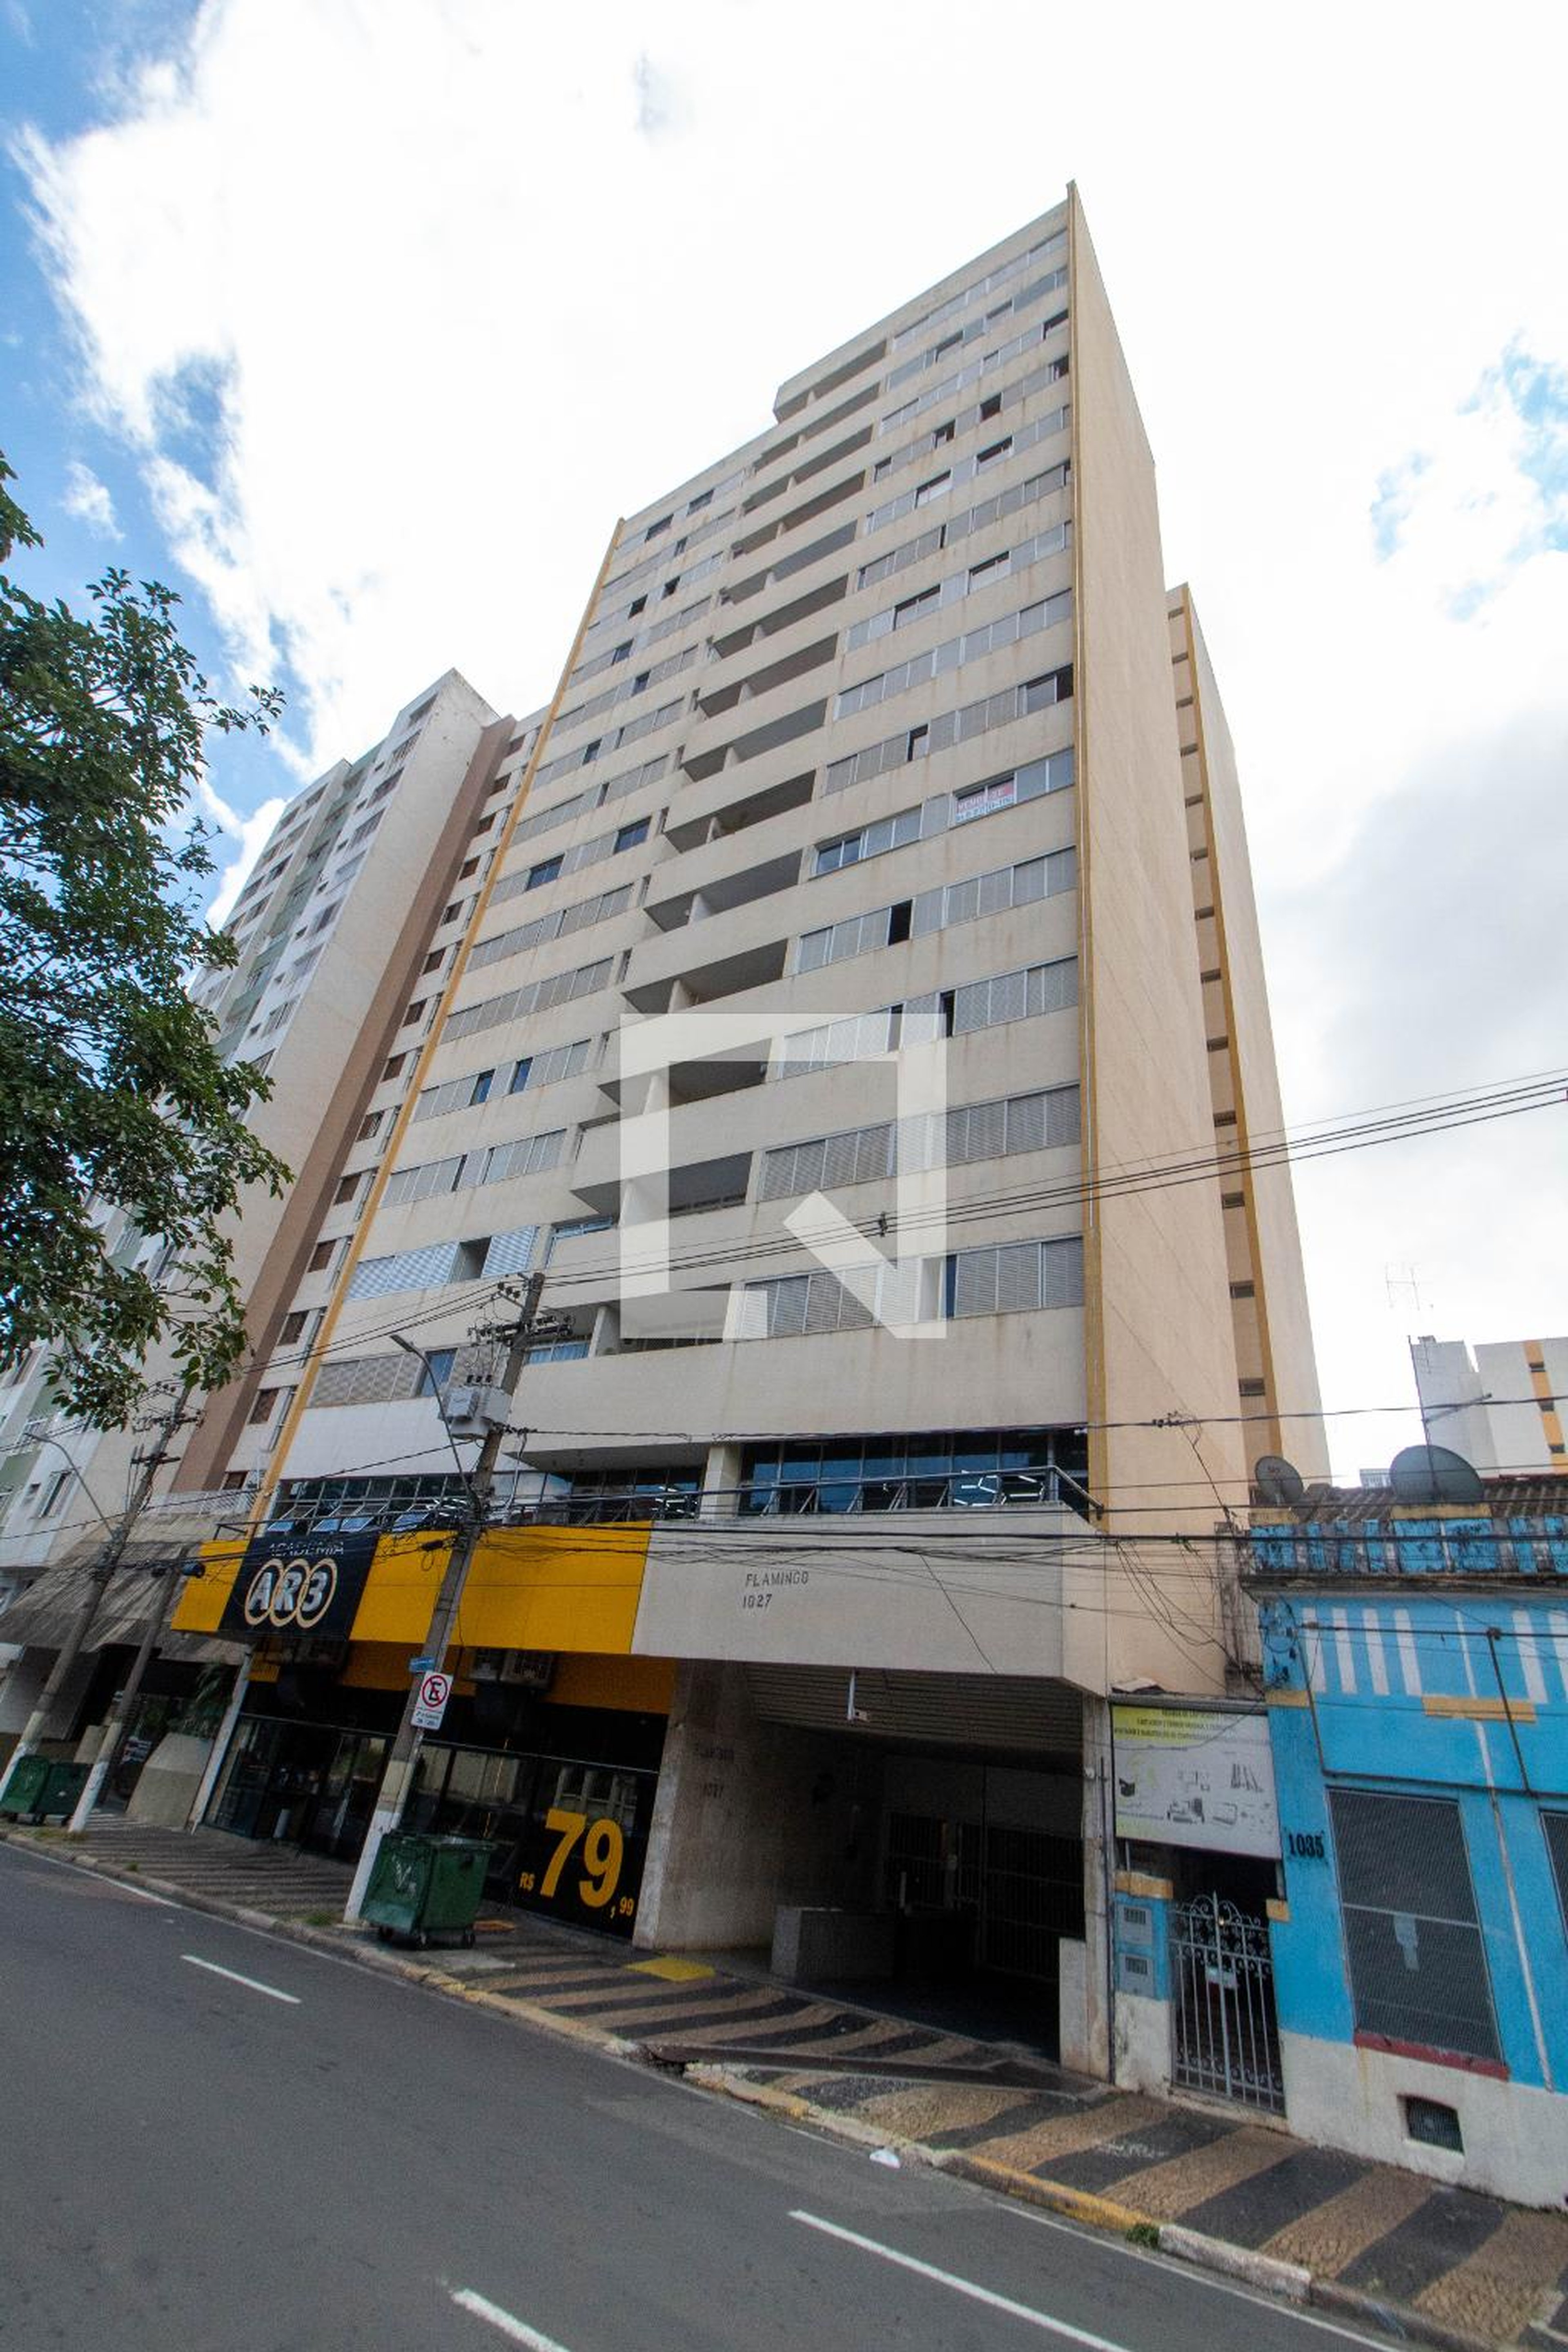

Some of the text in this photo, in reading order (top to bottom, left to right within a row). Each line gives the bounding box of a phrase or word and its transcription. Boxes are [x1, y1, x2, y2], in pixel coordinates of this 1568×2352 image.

[745, 1571, 808, 1587] FLAMINGO
[248, 1572, 327, 1612] AR3
[743, 1593, 773, 1608] 1027
[1289, 1833, 1324, 1858] 1035
[520, 1872, 535, 1891] R$
